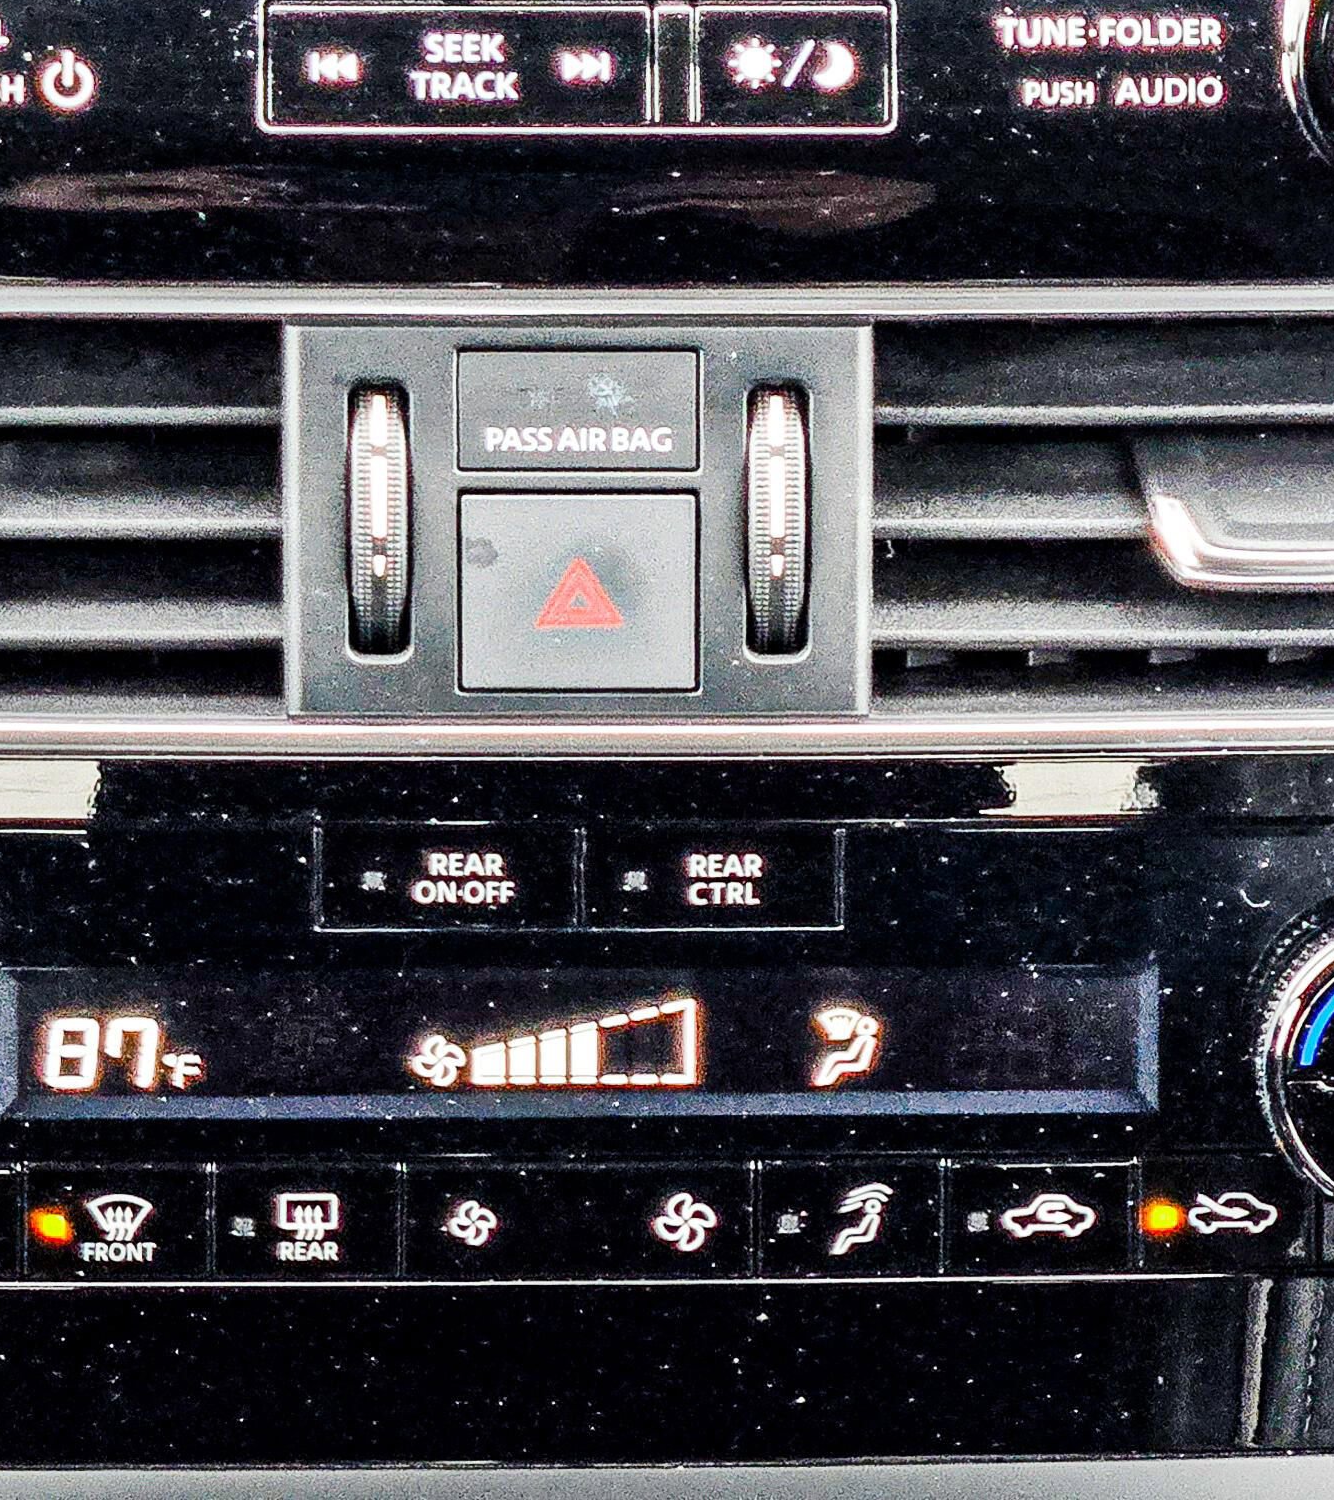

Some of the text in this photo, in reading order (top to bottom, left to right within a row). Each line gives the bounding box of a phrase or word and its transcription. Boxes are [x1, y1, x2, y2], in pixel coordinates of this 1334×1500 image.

[423, 33, 505, 64] SEEK
[410, 70, 519, 100] TRACK
[1022, 75, 1223, 106] PUSH AUDIO
[484, 426, 673, 452] PASS AIR BAG
[428, 853, 503, 878] REAR
[689, 853, 763, 878] REAR
[689, 881, 760, 906] CTRL
[82, 1242, 156, 1263] FRONT
[278, 1242, 339, 1261] REAR
